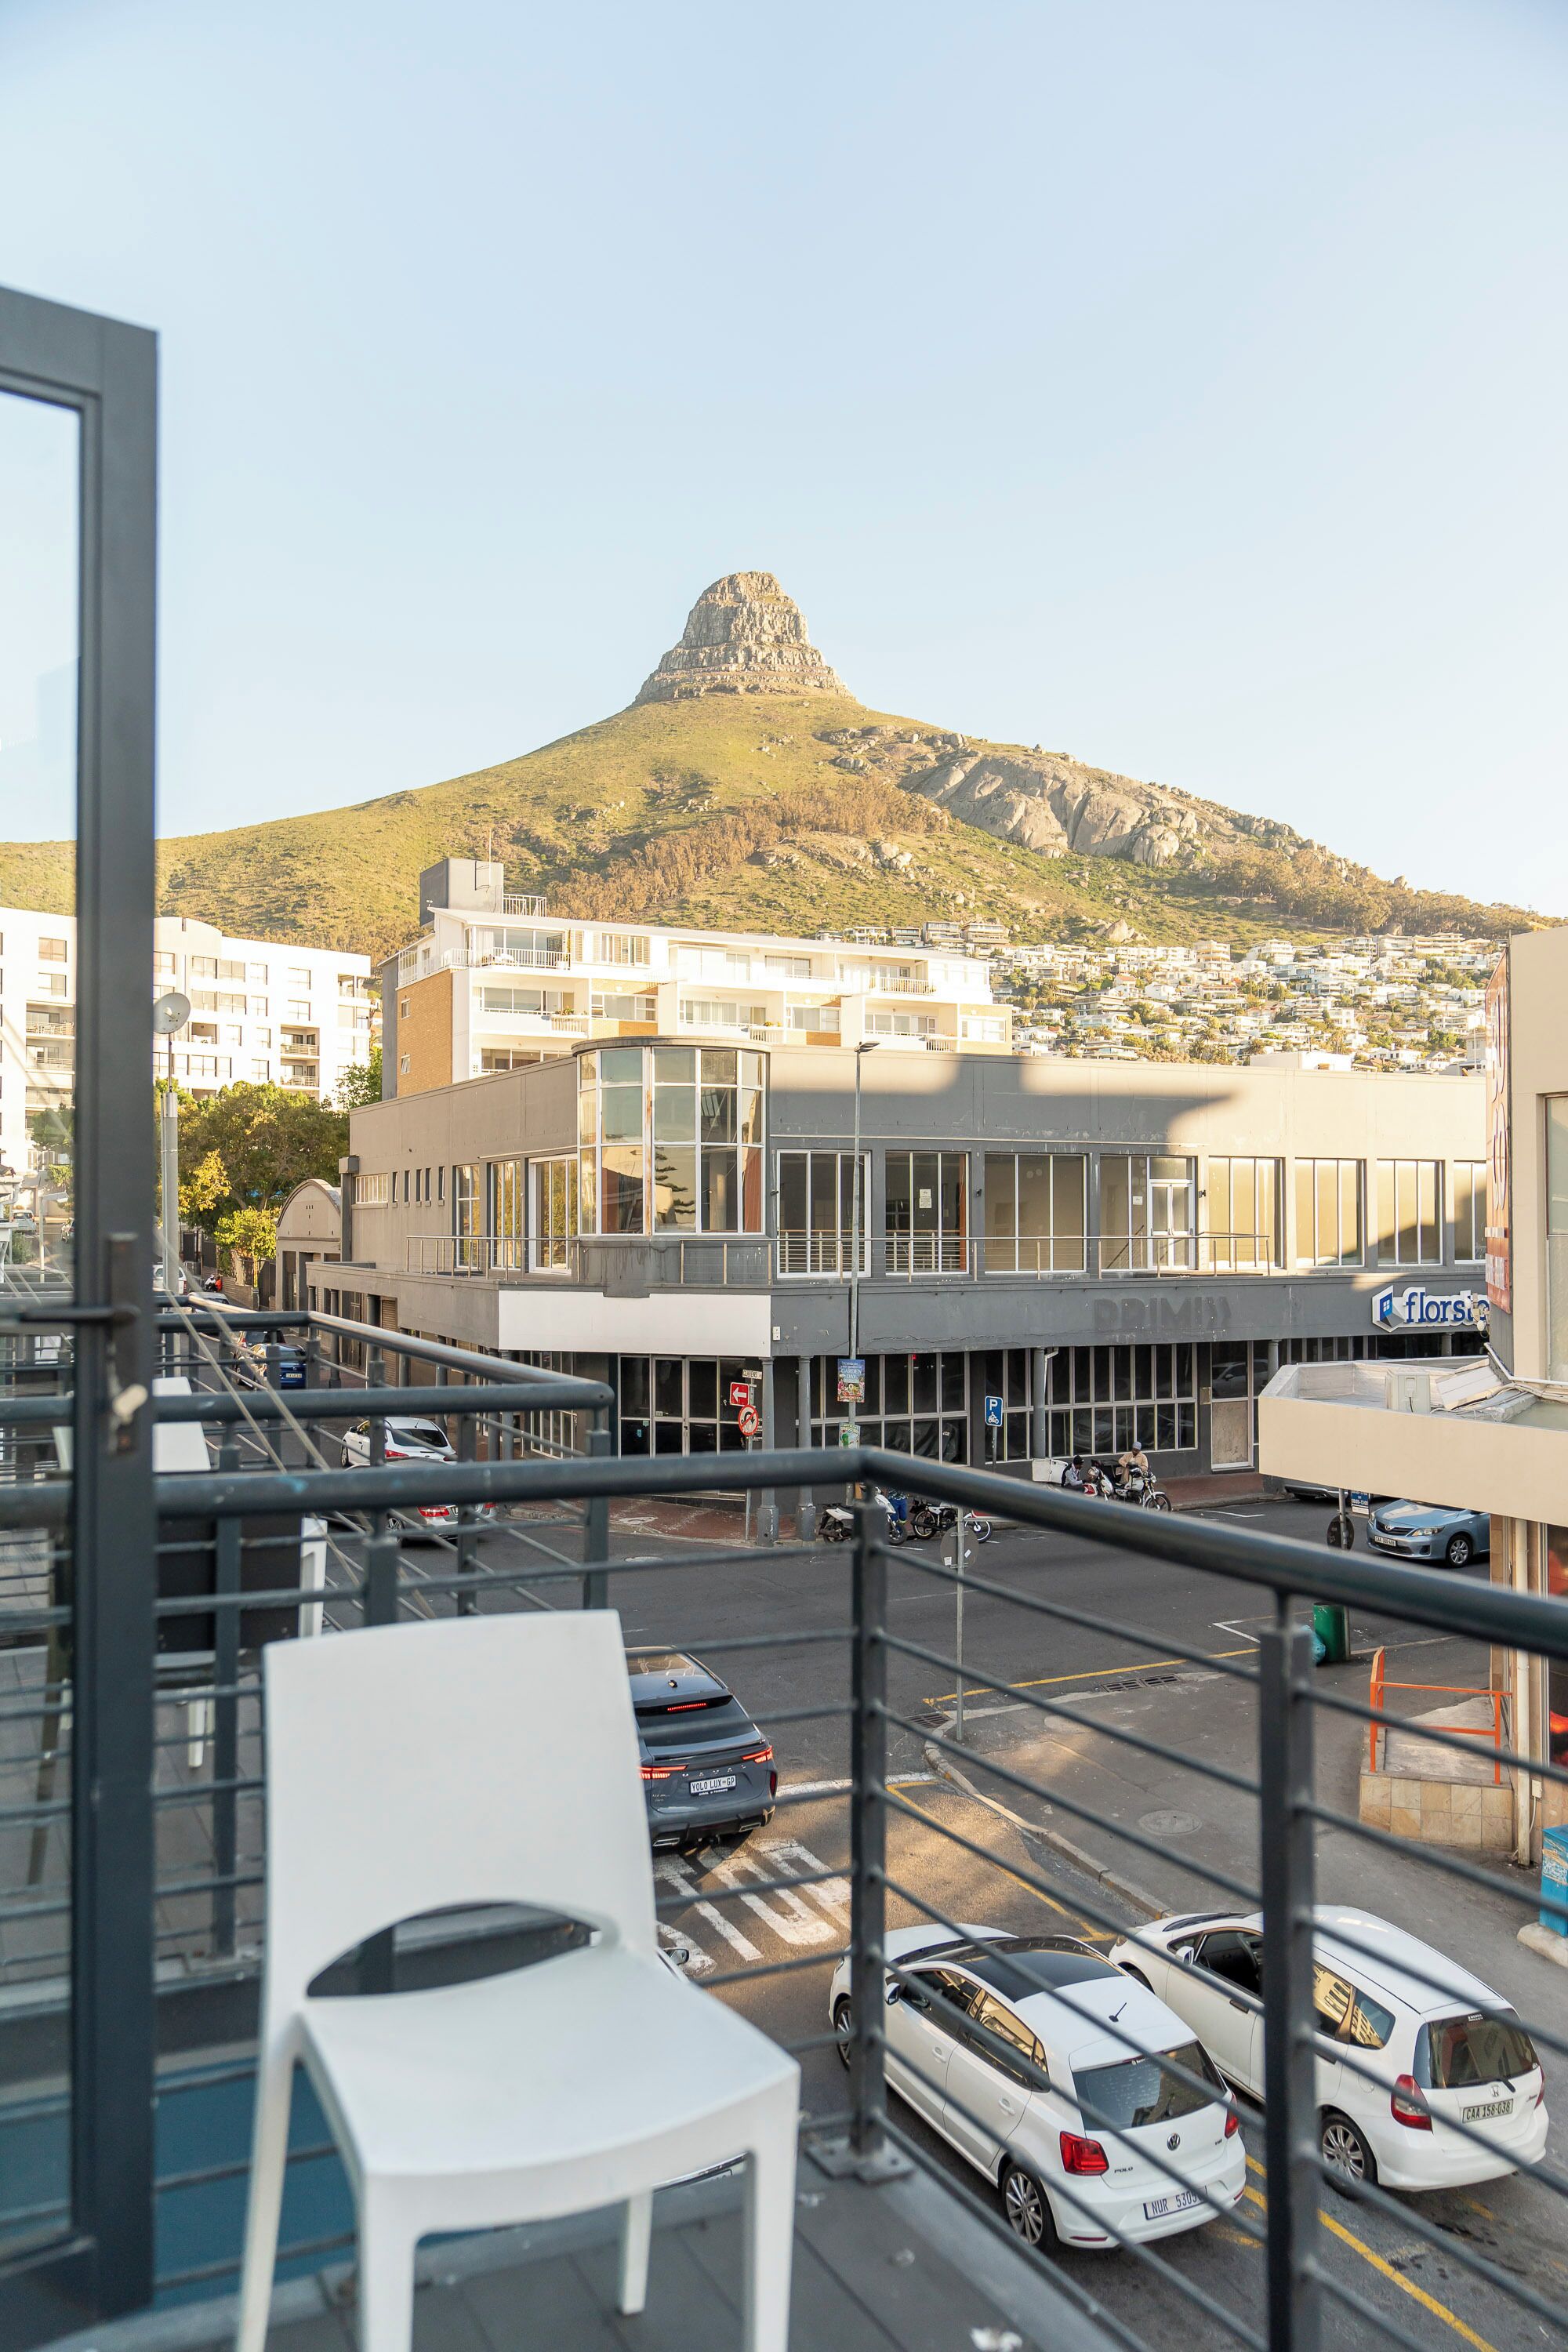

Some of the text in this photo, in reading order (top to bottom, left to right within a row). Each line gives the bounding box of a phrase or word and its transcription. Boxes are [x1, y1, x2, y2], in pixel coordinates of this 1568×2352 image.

[989, 1399, 998, 1411] P
[691, 1781, 708, 1792] YOLO
[710, 1779, 722, 1789] LUX
[727, 1777, 735, 1787] GP
[1466, 2101, 1511, 2121] CAA 158-038
[1152, 2198, 1169, 2216] NUR
